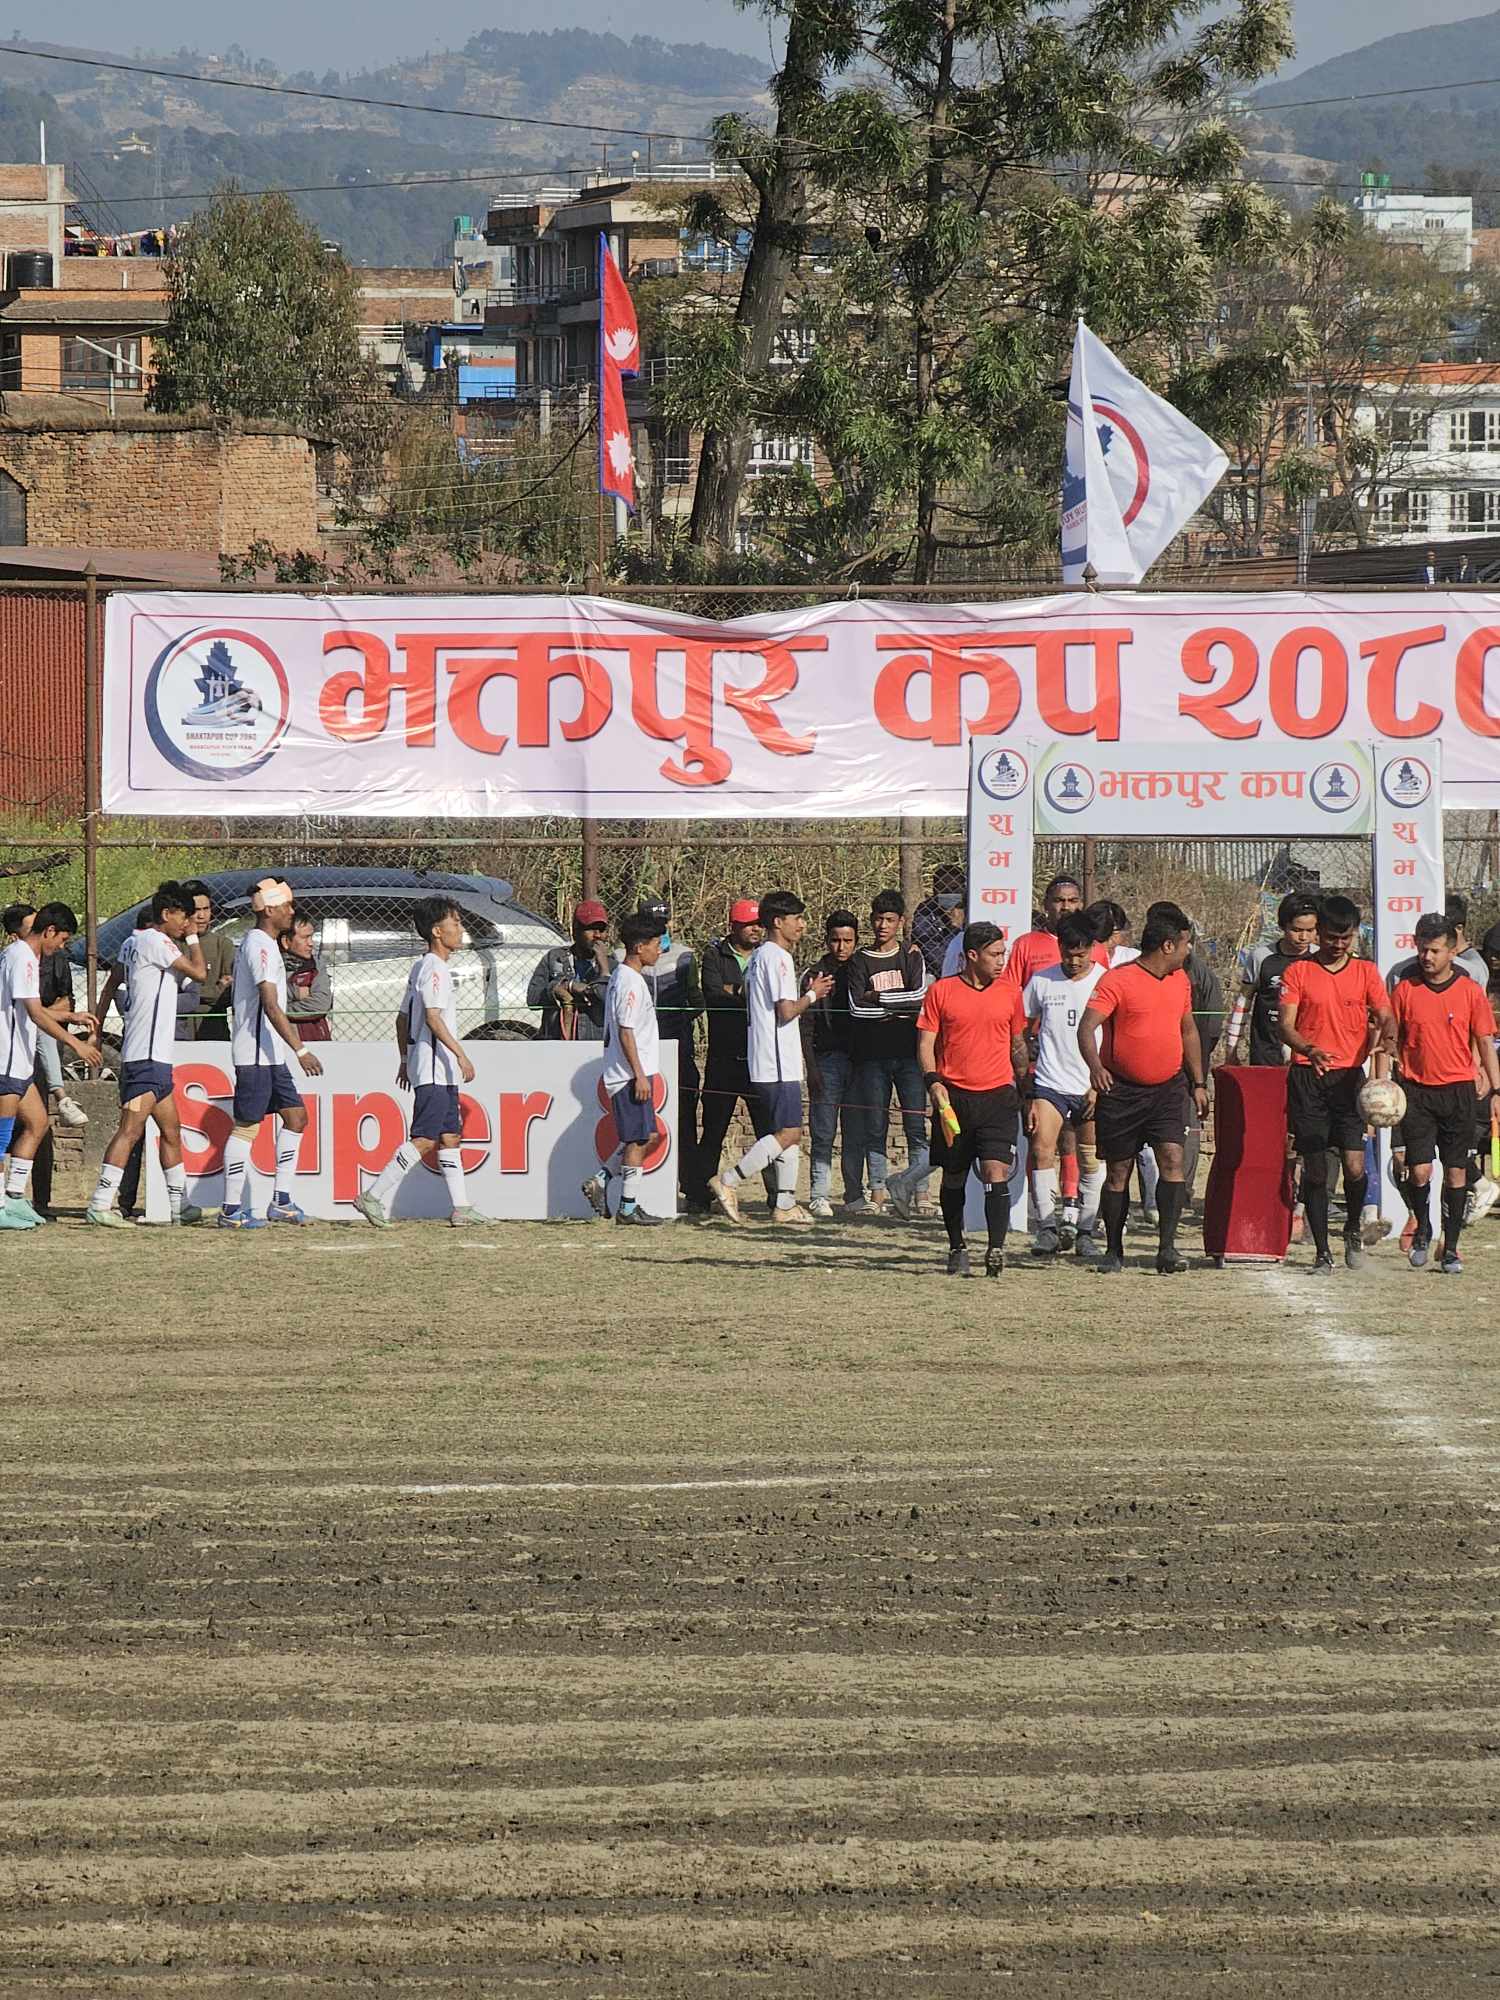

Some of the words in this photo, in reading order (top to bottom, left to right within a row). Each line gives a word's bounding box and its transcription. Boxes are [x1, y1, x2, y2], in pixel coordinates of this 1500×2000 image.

[319, 628, 828, 787] भक्तपुर
[873, 627, 1133, 746] कप
[1099, 769, 1226, 808] भक्तपुर
[1240, 770, 1306, 800] कप
[1067, 1009, 1077, 1027] 9
